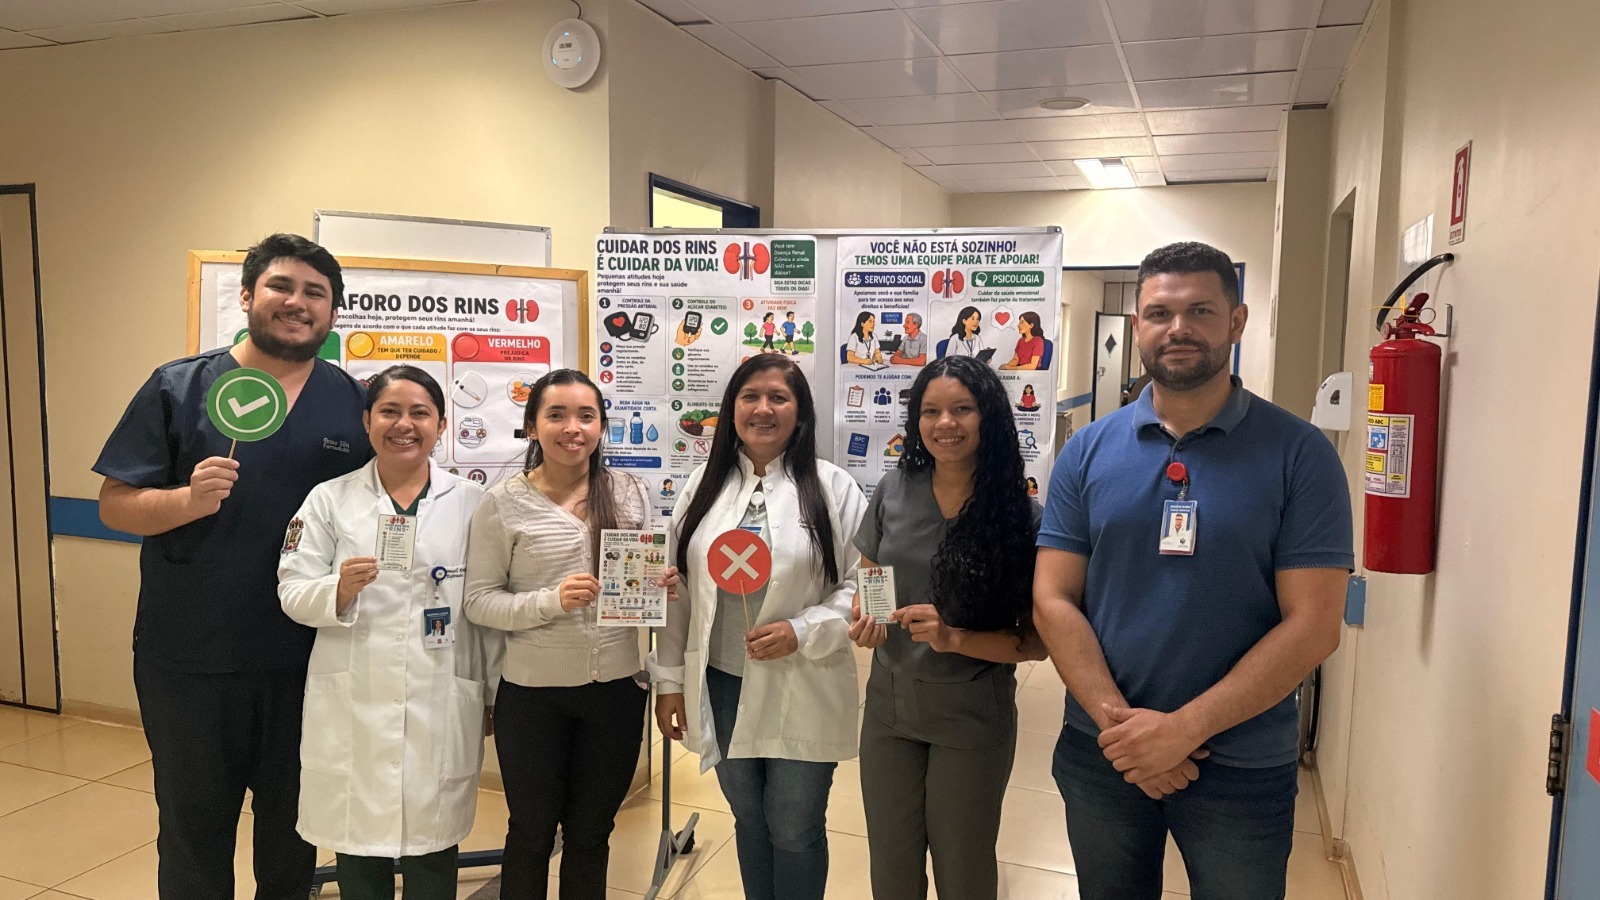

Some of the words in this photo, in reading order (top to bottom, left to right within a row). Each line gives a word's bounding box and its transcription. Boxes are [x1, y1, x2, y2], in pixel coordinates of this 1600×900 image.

[597, 239, 648, 254] CUIDAR
[653, 240, 681, 255] DOS
[685, 240, 717, 255] RINS
[870, 240, 900, 253] VOCÊ
[903, 239, 926, 253] NÃO
[930, 239, 958, 253] ESTÁ
[962, 241, 1016, 253] SOZINHO!
[597, 254, 604, 270] É
[608, 257, 660, 271] CUIDAR
[664, 258, 682, 271] DA
[685, 258, 719, 271] VIDA!
[855, 255, 888, 265] TEMOS
[891, 255, 914, 265] UMA
[918, 254, 952, 266] EQUIPE
[956, 254, 981, 264] PARA
[985, 254, 996, 264] TE
[1000, 254, 1039, 264] APOIAR!
[865, 275, 895, 284] SERVIÇO
[897, 275, 923, 284] SOCIAL
[992, 274, 1040, 284] PSICOLOGIA
[338, 294, 401, 312] AFORO
[409, 295, 448, 314] DOS
[454, 297, 499, 315] RINS
[368, 314, 384, 322] hoje,
[380, 335, 434, 346] AMARELO
[488, 337, 541, 349] VERMELHO
